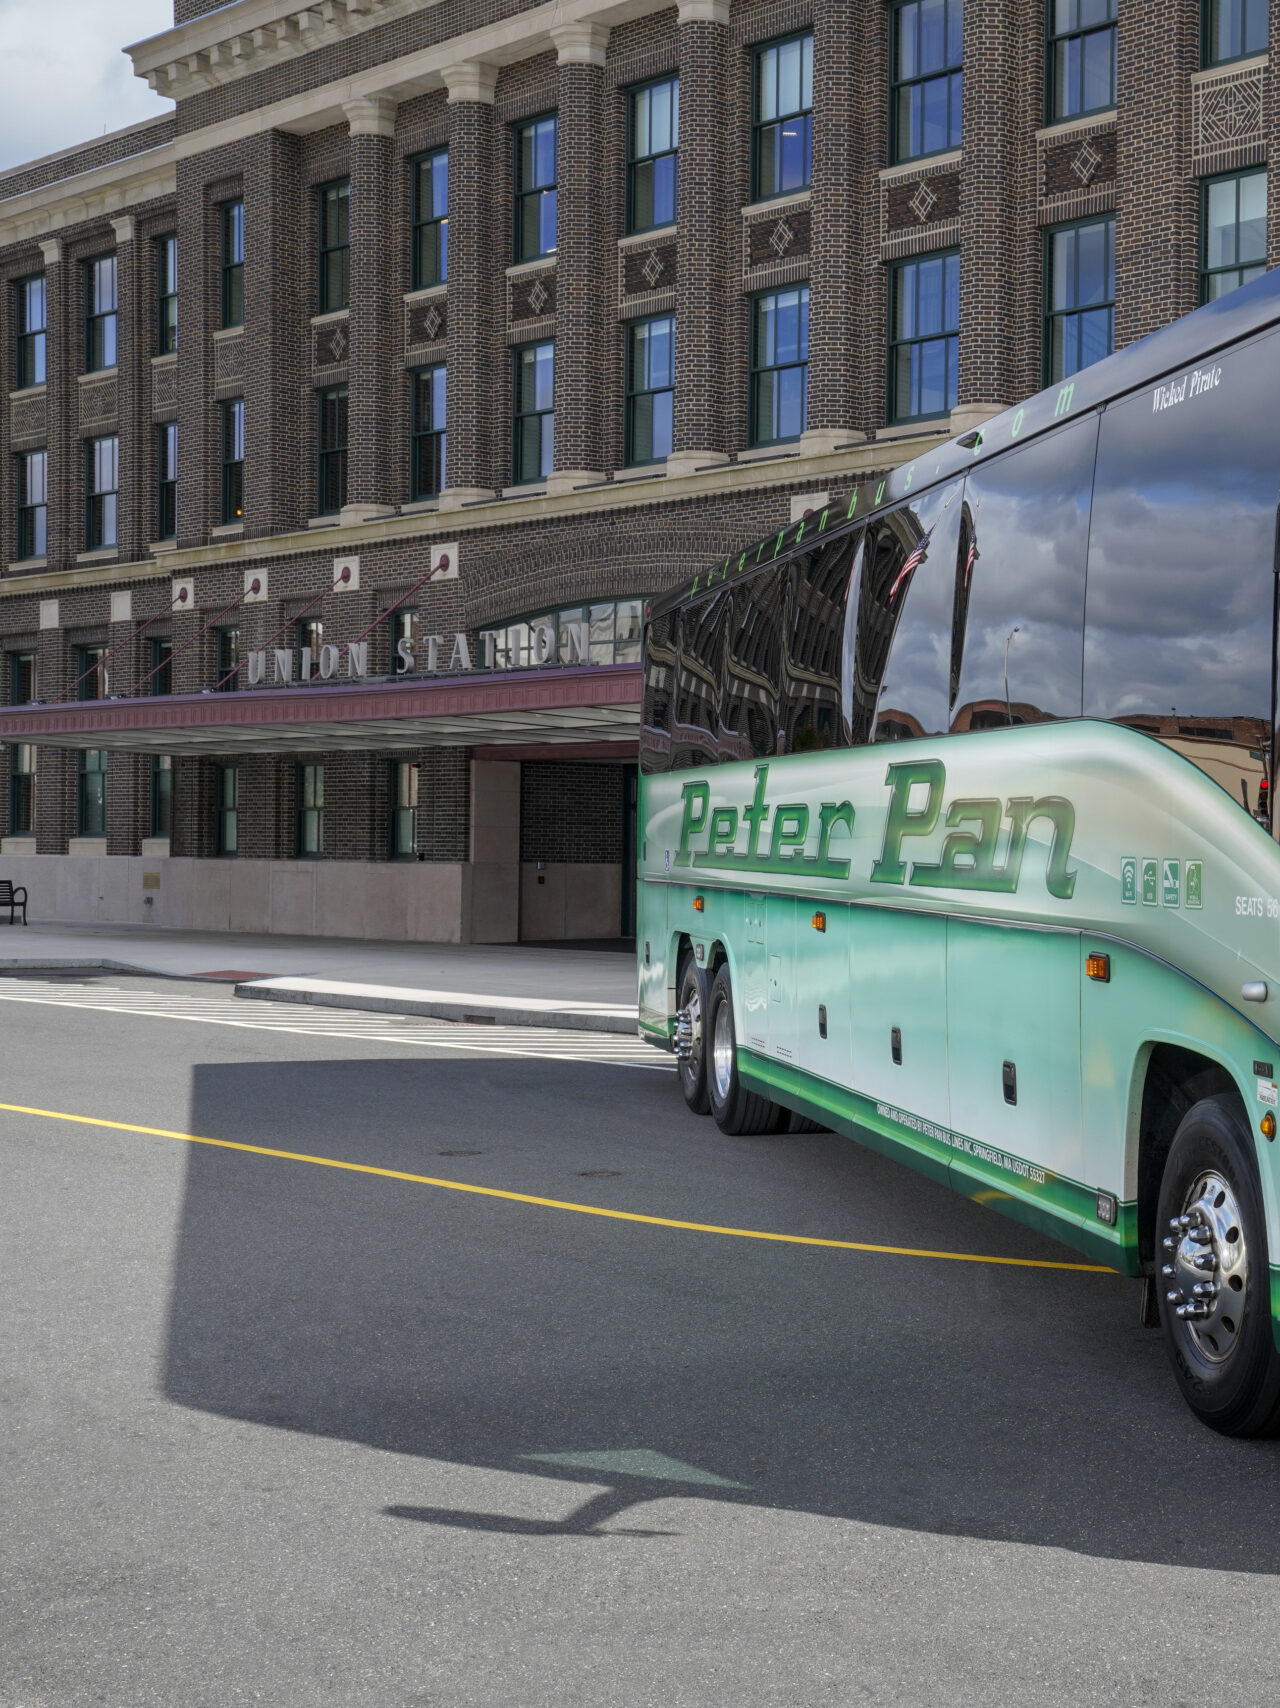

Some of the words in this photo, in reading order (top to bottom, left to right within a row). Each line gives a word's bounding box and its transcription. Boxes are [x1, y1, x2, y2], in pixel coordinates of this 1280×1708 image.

[1153, 376, 1187, 413] Wicked
[1189, 365, 1221, 398] Pirate
[249, 641, 368, 685] UNION
[397, 622, 590, 675] STATION
[674, 763, 856, 880] Peter
[870, 758, 1078, 899] Pan
[1235, 896, 1263, 917] SEATS
[951, 1135, 964, 1150] LINES
[1012, 1160, 1029, 1178] USDOT
